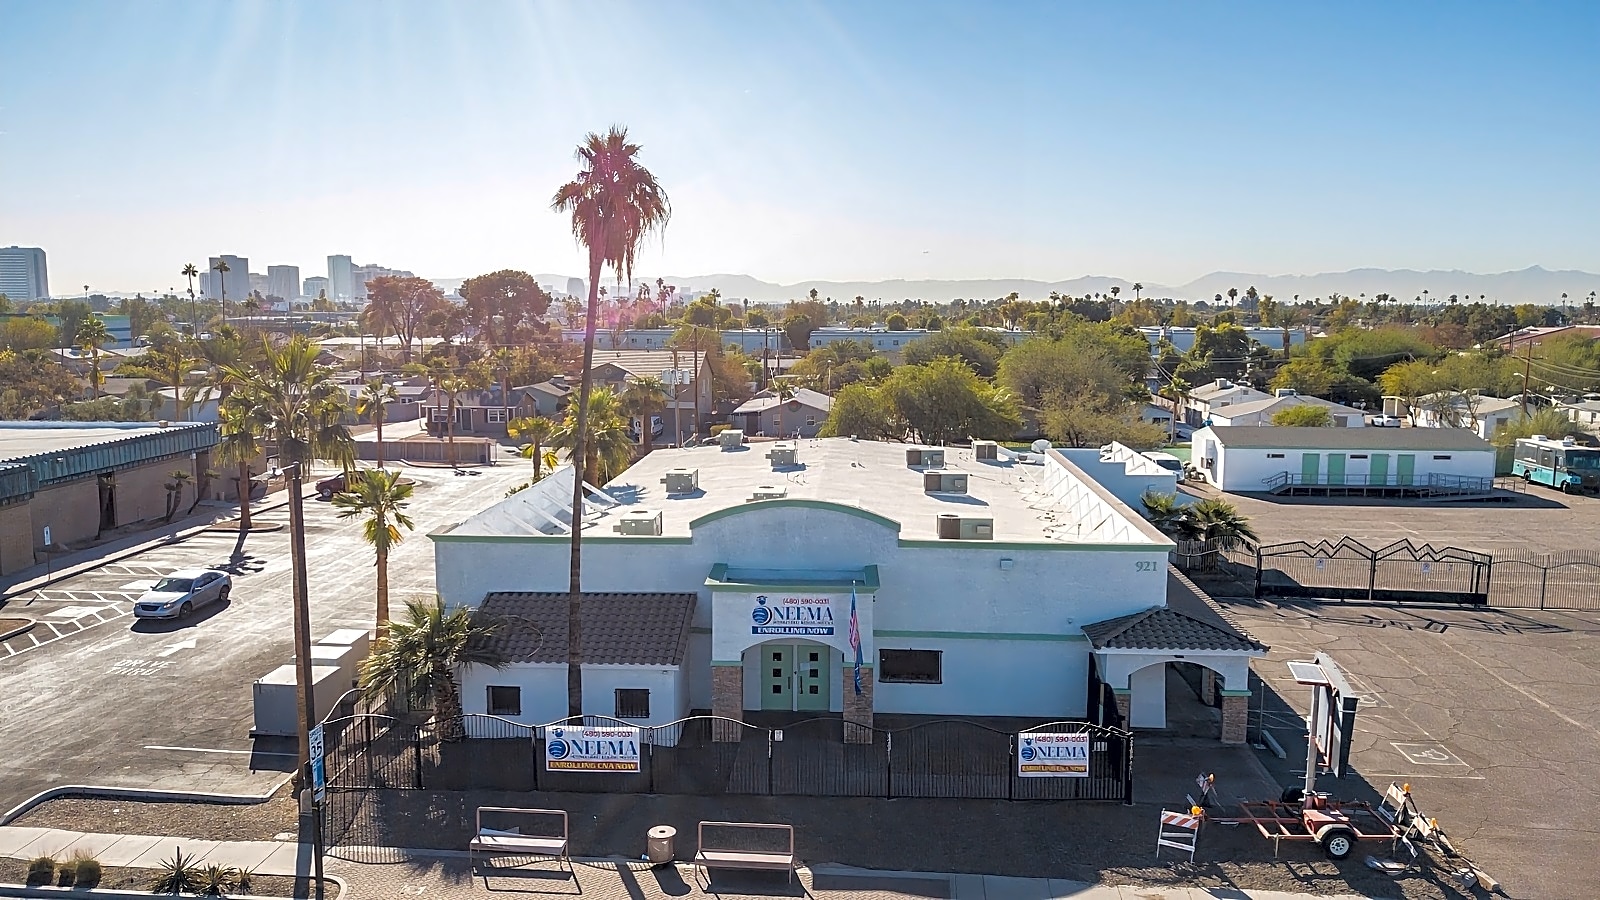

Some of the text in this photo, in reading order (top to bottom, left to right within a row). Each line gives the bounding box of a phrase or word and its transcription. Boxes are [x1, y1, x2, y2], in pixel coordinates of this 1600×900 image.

[1135, 561, 1157, 572] 921
[773, 607, 833, 620] NEEMA
[582, 730, 600, 738] (480)
[311, 741, 322, 760] 35
[571, 740, 637, 755] NEEMA
[1038, 747, 1086, 757] NEEMA
